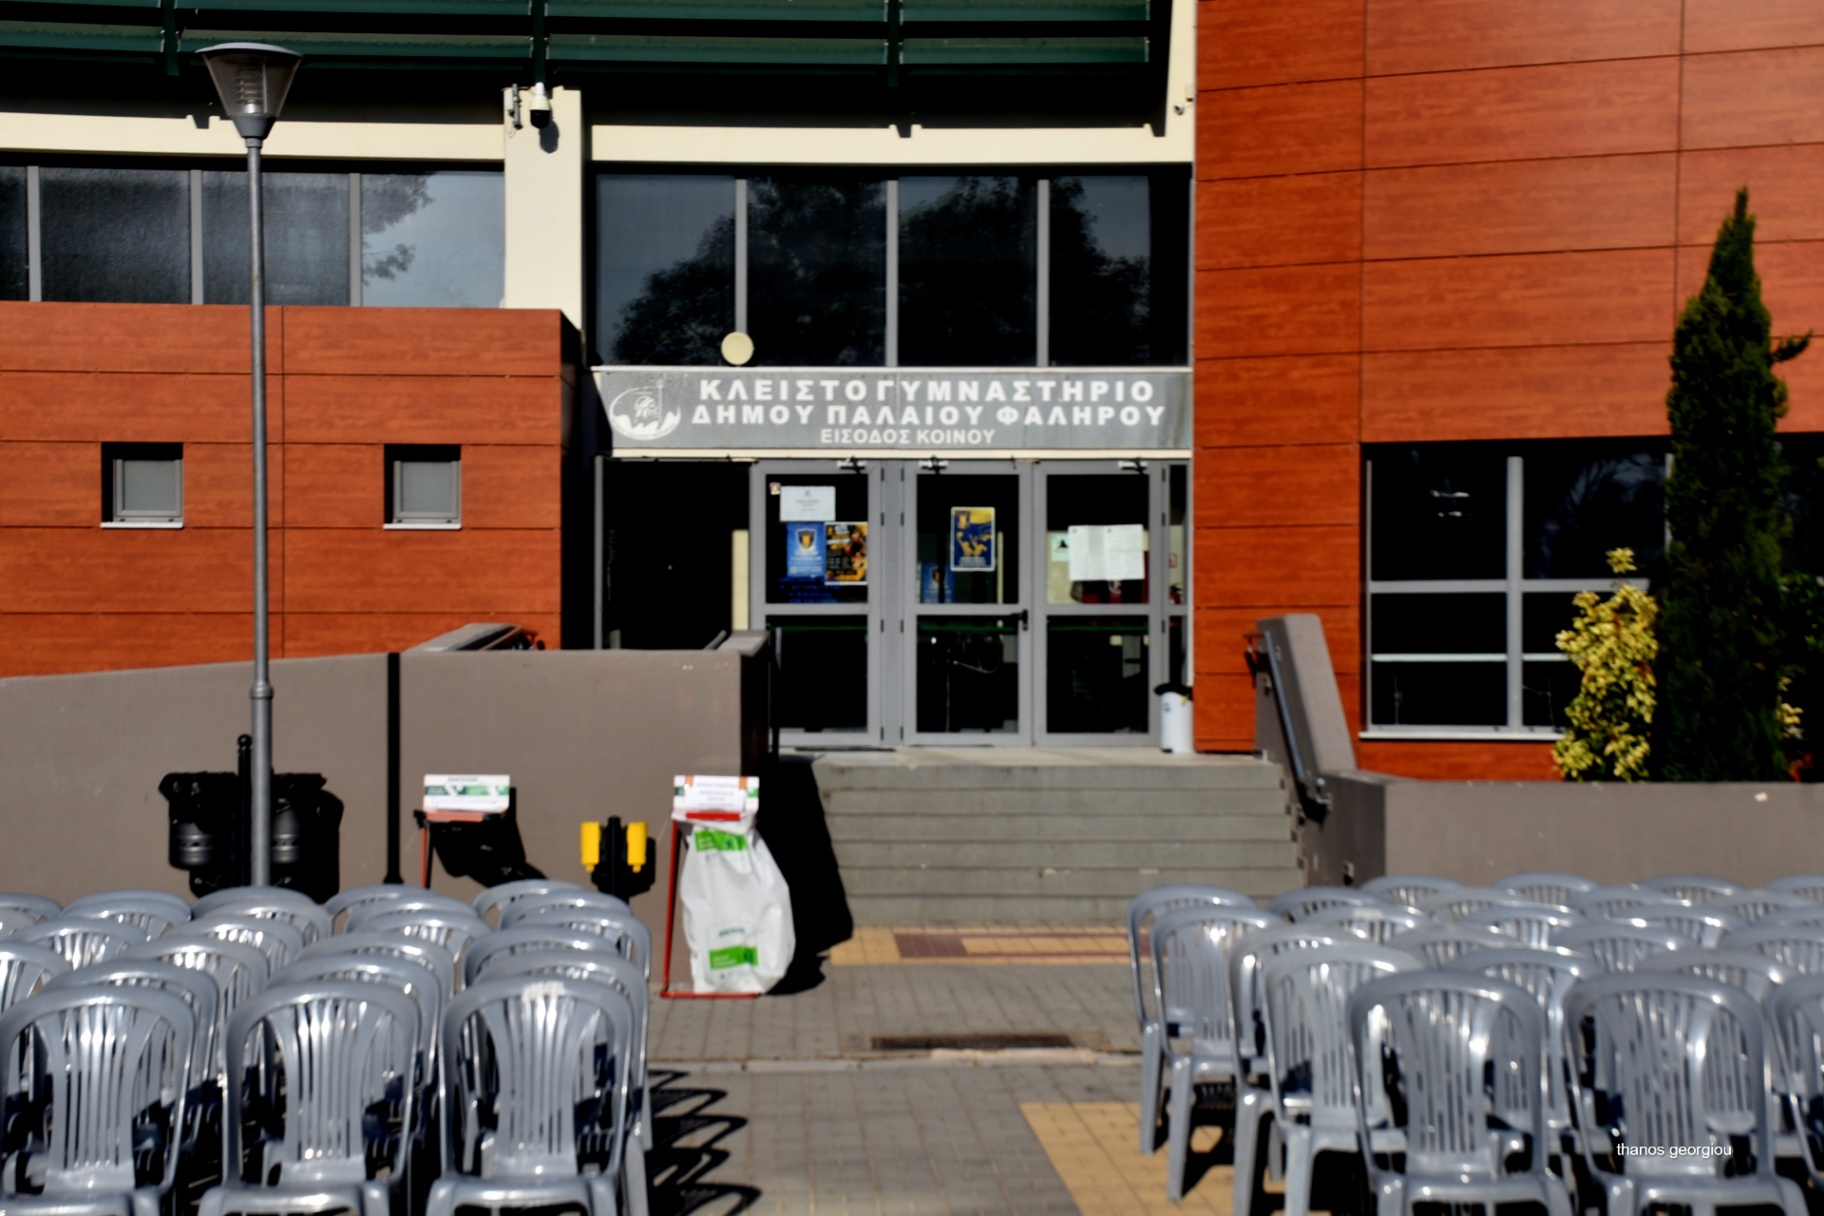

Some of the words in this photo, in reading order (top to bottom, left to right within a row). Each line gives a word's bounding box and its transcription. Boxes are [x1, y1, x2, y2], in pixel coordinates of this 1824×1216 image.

[691, 404, 814, 425] ΔΗΜΟΥ
[827, 405, 984, 426] ΠΑΛΑΙΟΥ
[996, 405, 1165, 426] ΦΑΛΗΡΟΥ
[820, 428, 910, 444] ΕΙΣΟΔΟΣ
[916, 429, 996, 445] ΚΟΙΝΟΥ
